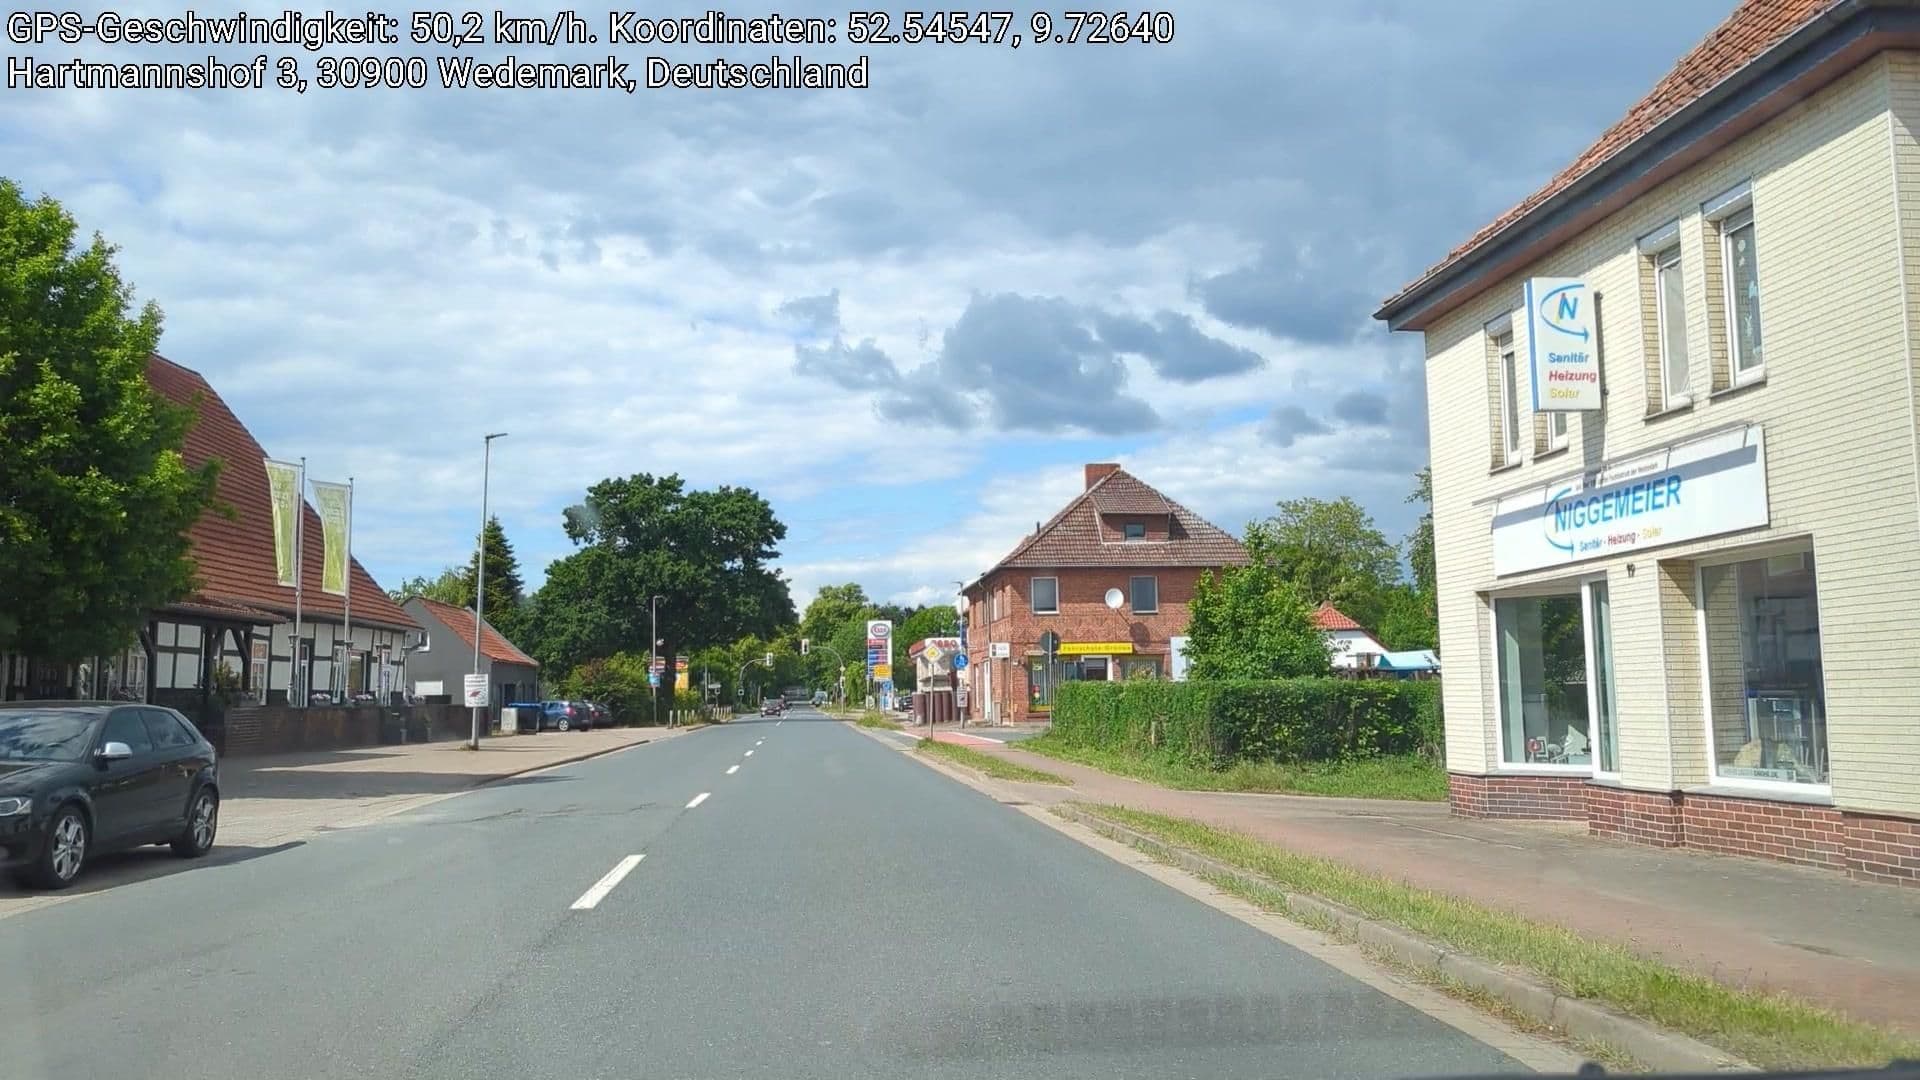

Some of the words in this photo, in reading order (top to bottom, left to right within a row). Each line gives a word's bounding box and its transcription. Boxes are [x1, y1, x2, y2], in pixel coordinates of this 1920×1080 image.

[1548, 352, 1590, 363] Sanitär
[1548, 370, 1597, 383] Heizung
[1554, 475, 1682, 533] NIGGEMEIER
[1607, 532, 1637, 546] Heizung
